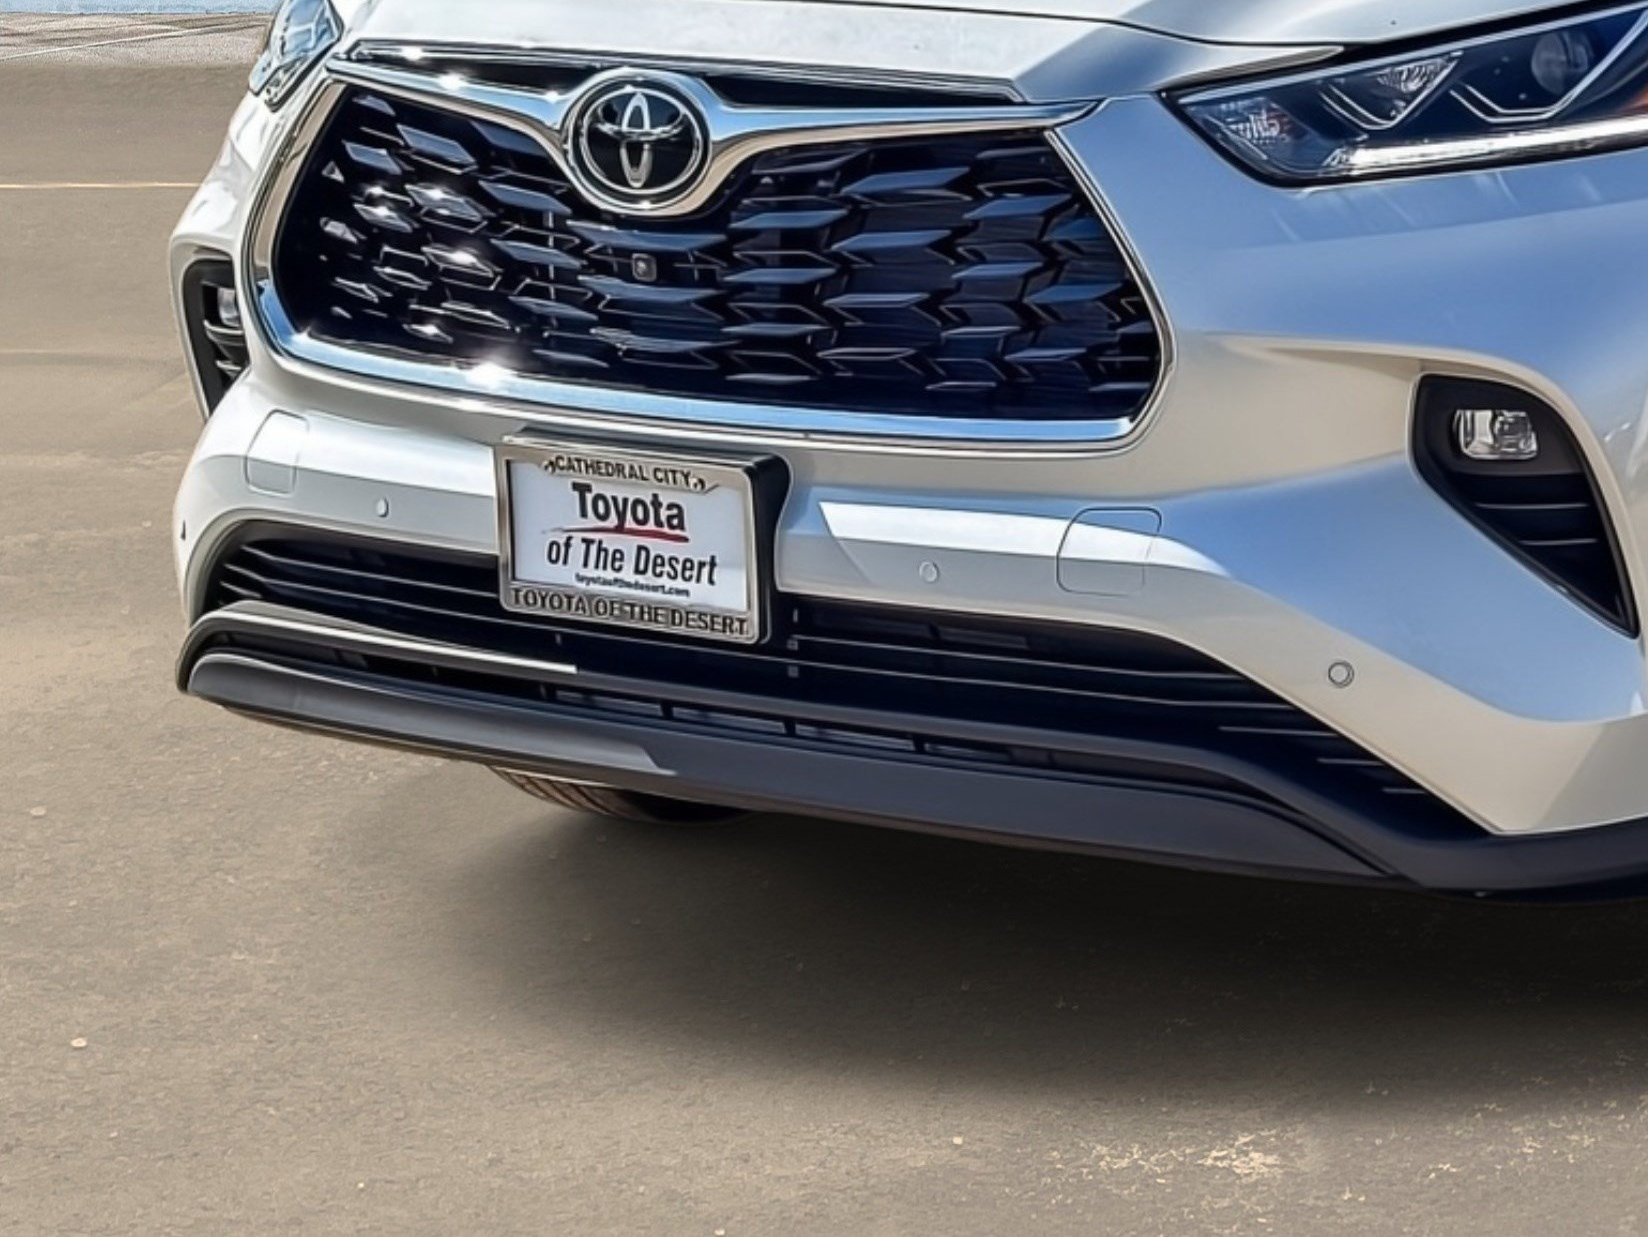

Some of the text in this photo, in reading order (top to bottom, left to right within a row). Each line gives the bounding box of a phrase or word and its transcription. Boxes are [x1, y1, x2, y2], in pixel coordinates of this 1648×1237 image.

[555, 455, 691, 487] CATHEDRAL CITY
[571, 481, 686, 532] Toyota
[547, 535, 718, 586] of The Desert
[512, 587, 749, 636] TOYOTA OF THE DESERT
